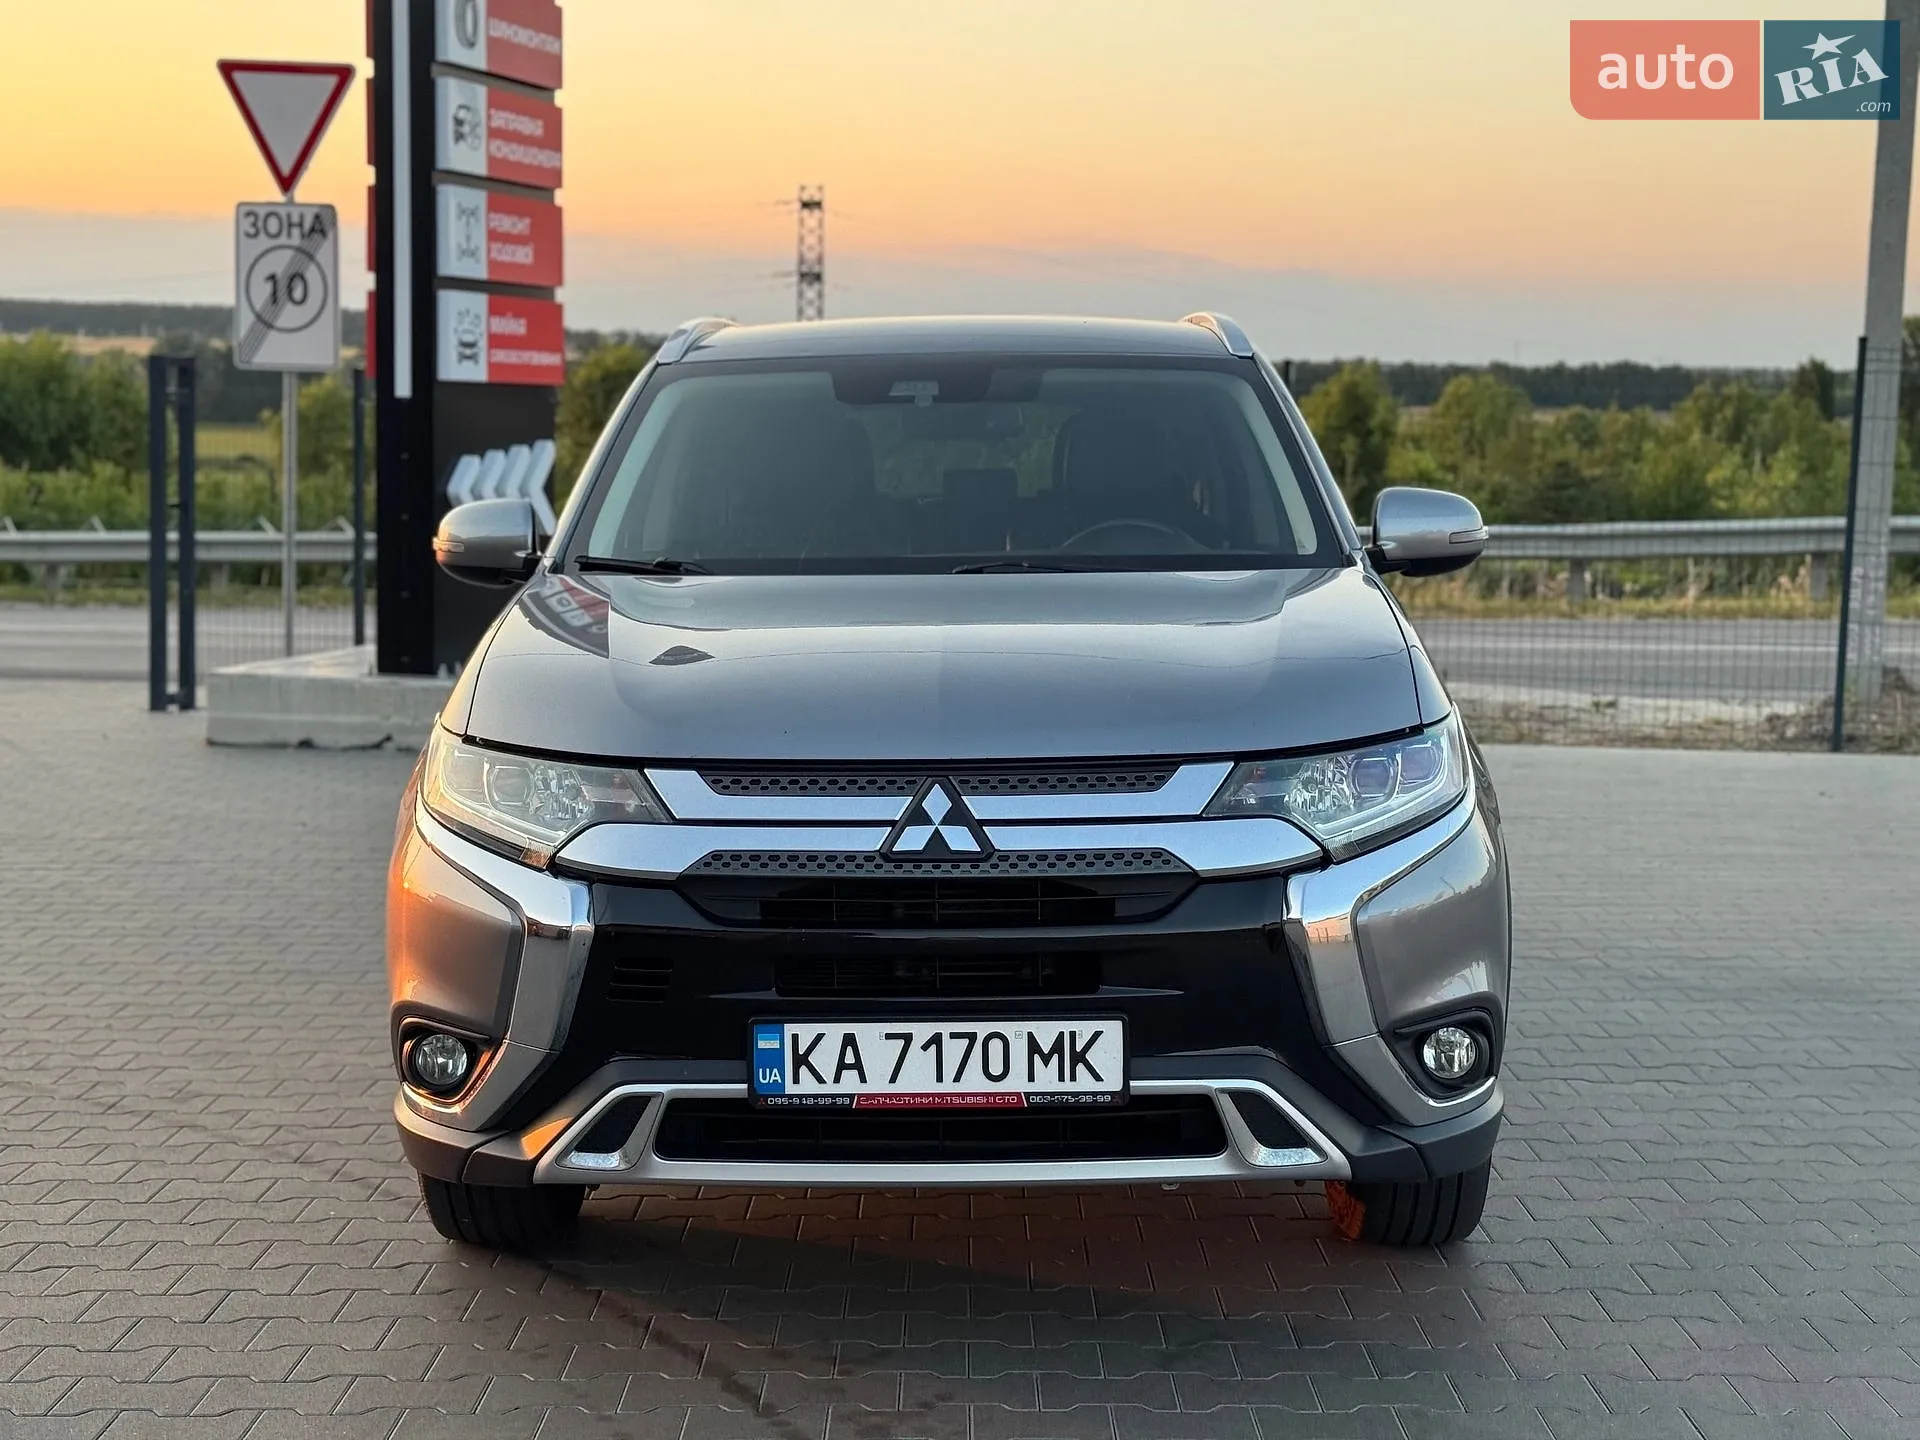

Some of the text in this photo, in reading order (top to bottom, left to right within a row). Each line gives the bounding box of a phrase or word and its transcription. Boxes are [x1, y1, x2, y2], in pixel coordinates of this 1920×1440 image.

[243, 211, 328, 239] ЗОНА
[264, 271, 309, 306] 10
[791, 1030, 1105, 1084] KA 7170 MK
[759, 1068, 782, 1084] UA
